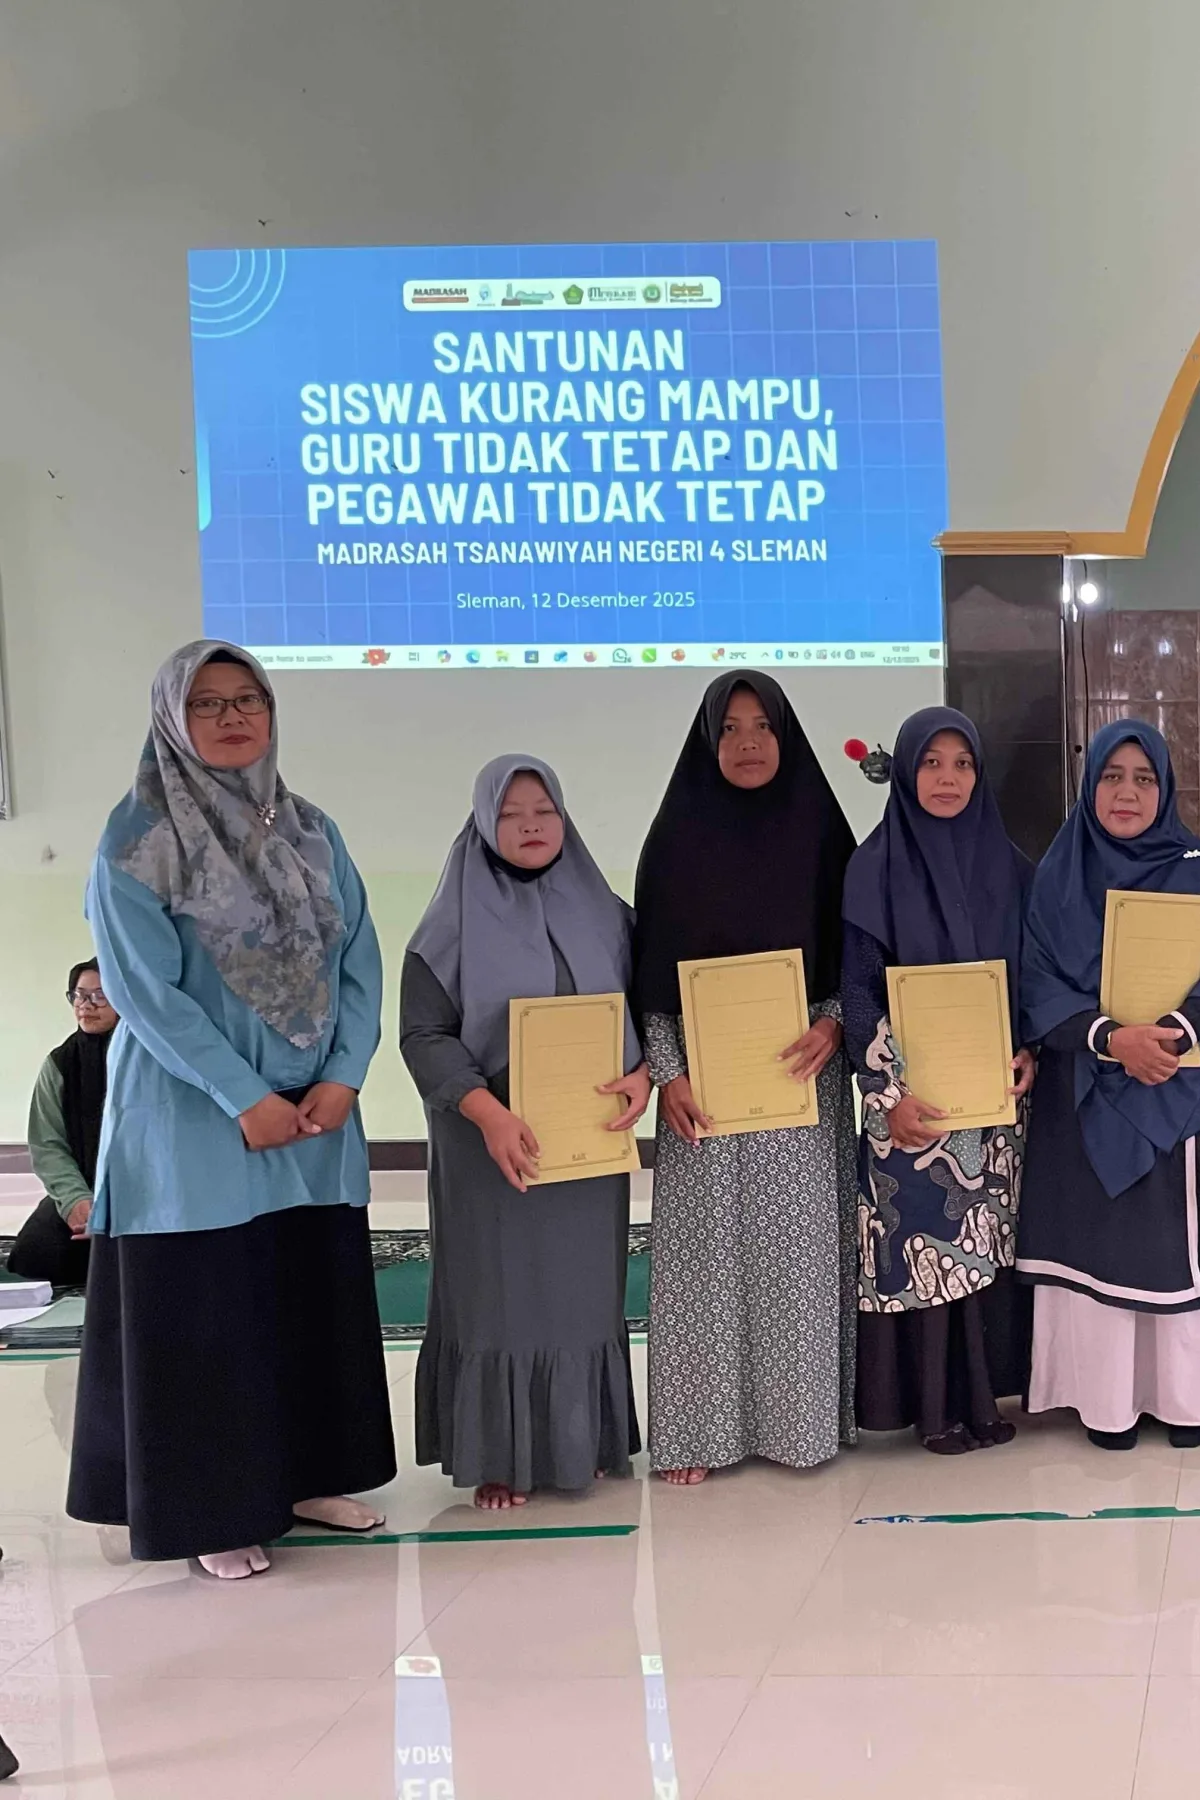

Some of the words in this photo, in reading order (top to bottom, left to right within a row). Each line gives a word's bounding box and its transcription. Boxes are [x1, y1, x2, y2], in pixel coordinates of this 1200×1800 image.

[433, 329, 684, 374] SANTUNAN
[300, 381, 447, 425] SISWA
[459, 380, 646, 424] KURANG
[658, 378, 834, 425] MAMPU,
[301, 432, 421, 475] GURU
[433, 431, 572, 474] TIDAK
[582, 429, 731, 473] TETAP
[744, 428, 838, 471] DAN
[307, 482, 515, 526] PEGAWAI
[527, 480, 665, 524] TIDAK
[676, 479, 826, 522] TETAP
[317, 541, 447, 565] MADRASAH
[453, 540, 612, 564] TSANAWIYAH
[619, 539, 704, 563] NEGERI
[709, 539, 725, 562] 4
[731, 538, 828, 562] SLEMAN
[456, 592, 525, 610] Sleman,
[532, 592, 551, 608] 12
[557, 592, 647, 608] Desember
[652, 591, 695, 608] 2025
